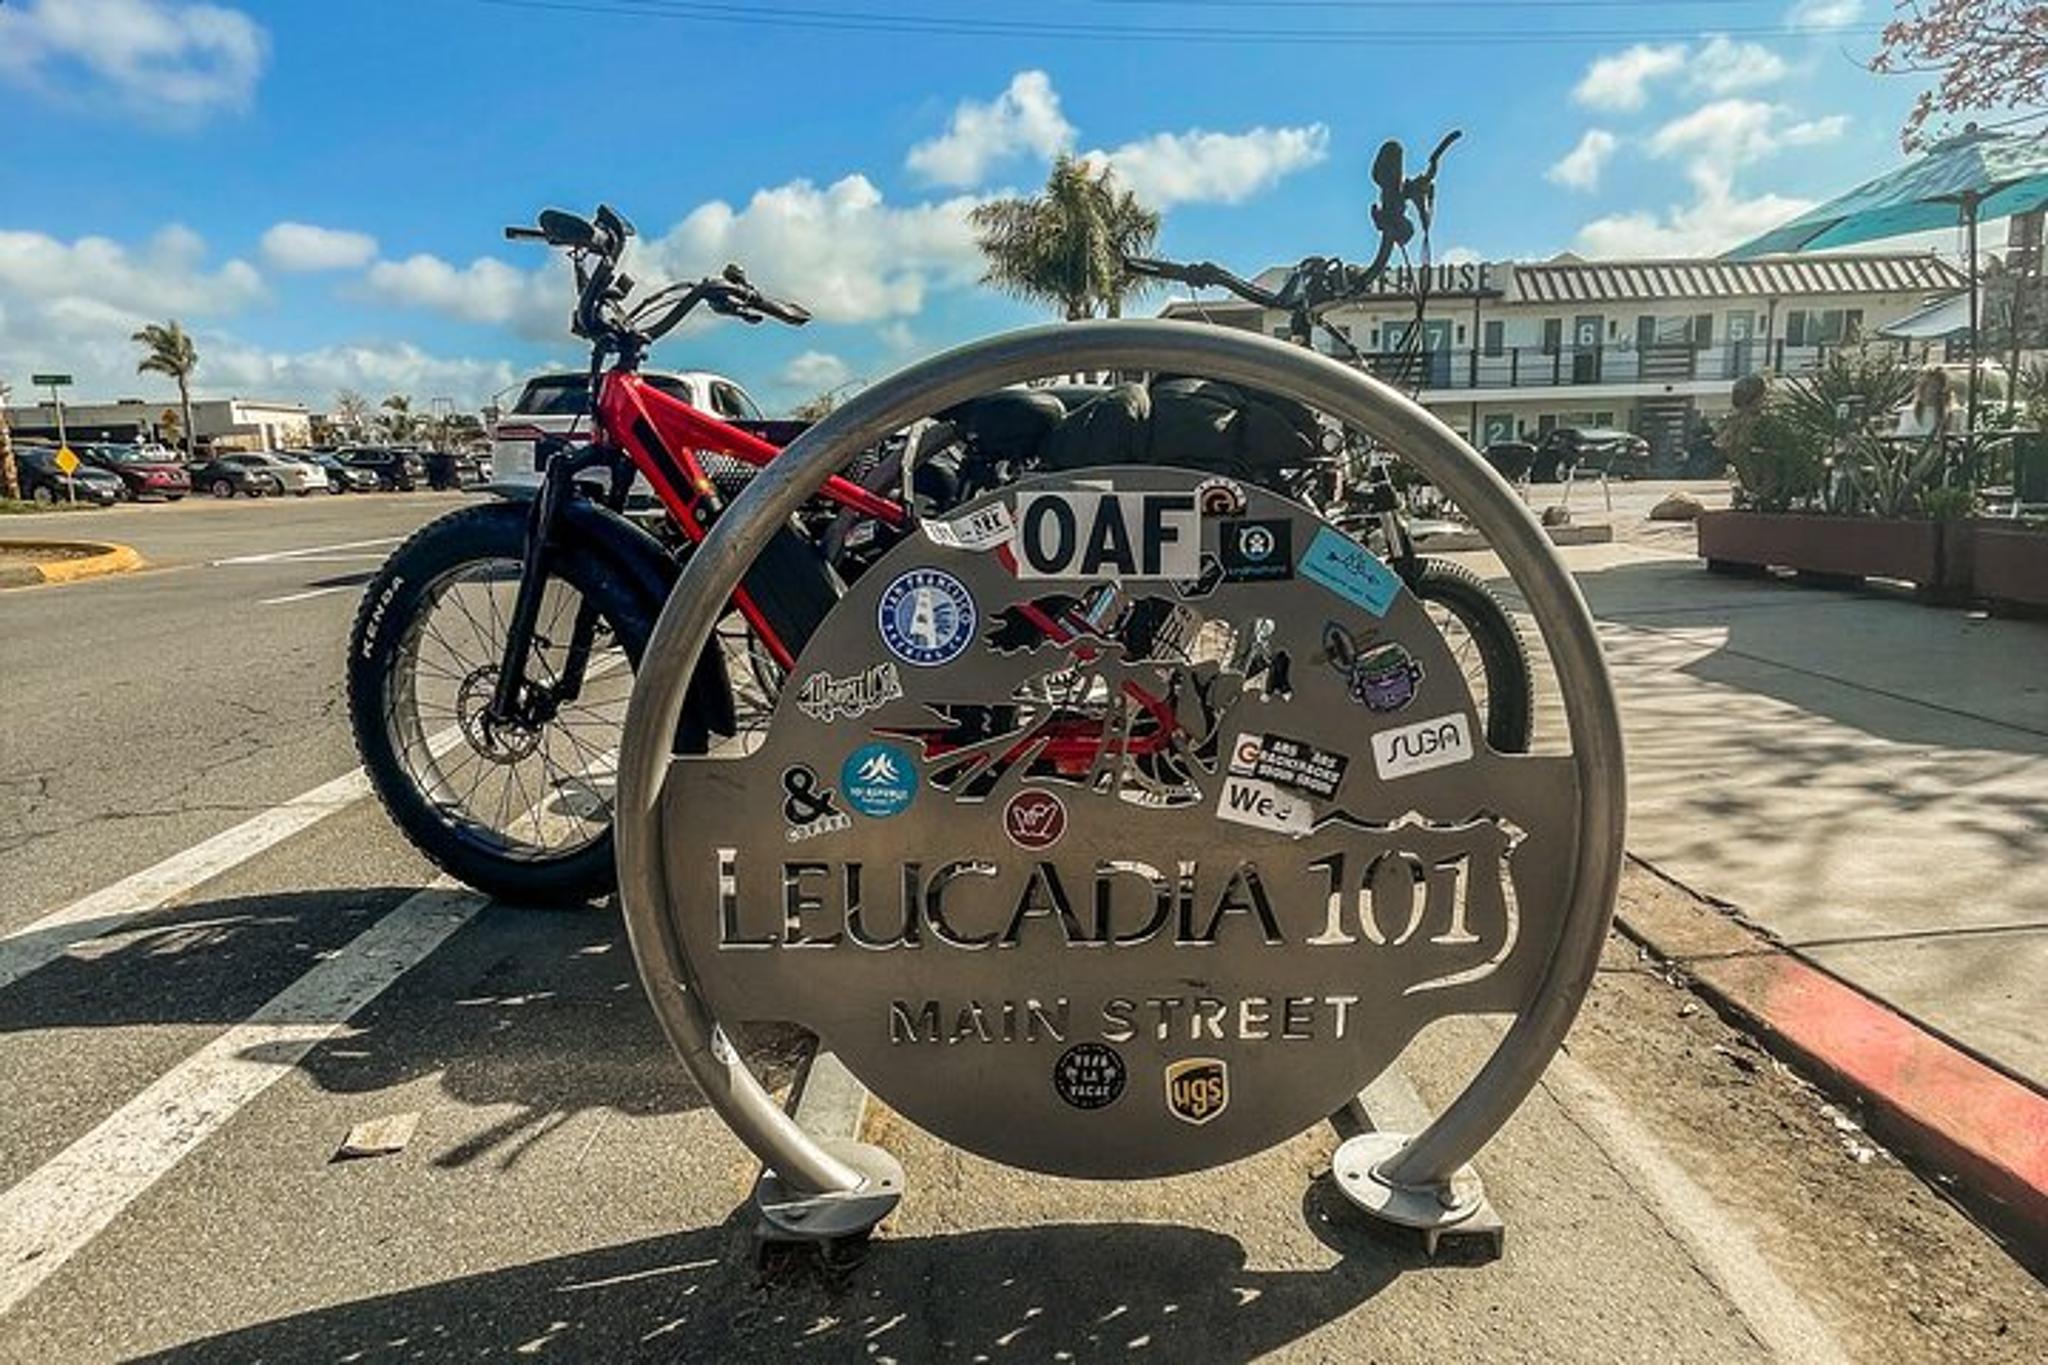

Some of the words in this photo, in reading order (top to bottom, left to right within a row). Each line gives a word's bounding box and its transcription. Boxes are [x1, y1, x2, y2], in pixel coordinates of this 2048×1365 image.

[1429, 329, 1444, 351] 7
[1579, 322, 1596, 346] 6
[1023, 494, 1194, 576] OAF
[362, 575, 405, 659] KENDA
[1387, 722, 1461, 764] SUGA
[717, 847, 1285, 951] LEUCADIA
[1306, 850, 1481, 946] 101
[888, 999, 1072, 1044] MAIN
[1100, 995, 1359, 1044] STREET
